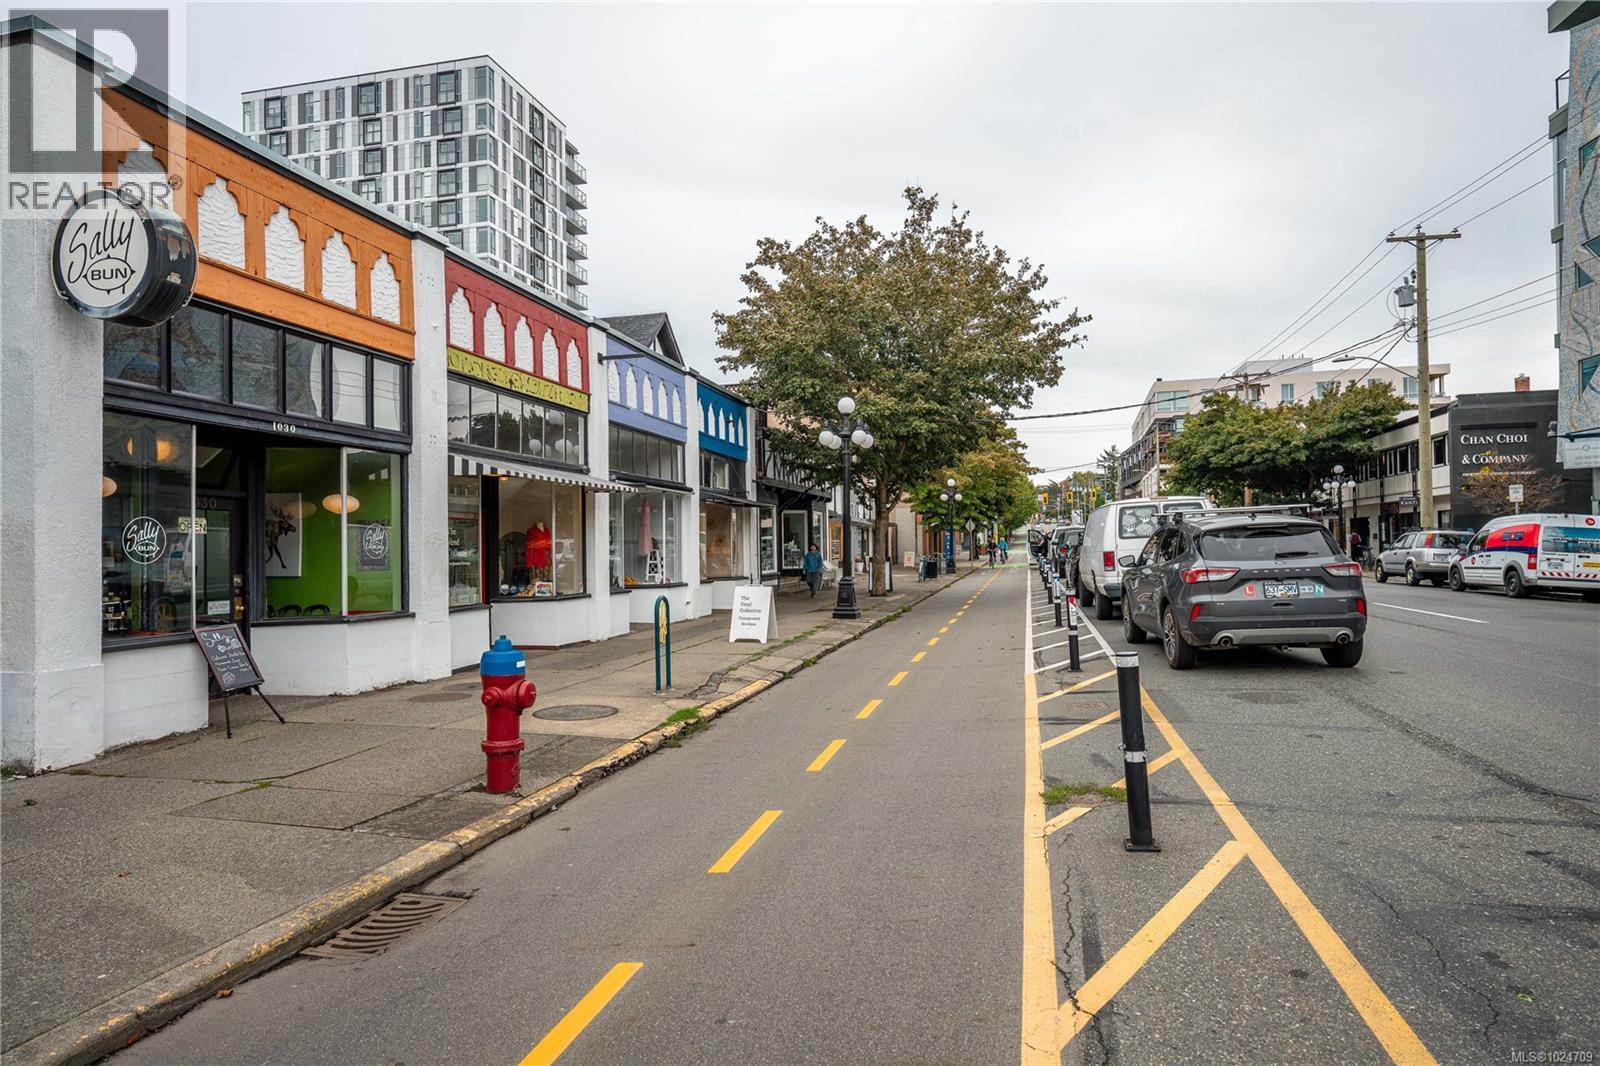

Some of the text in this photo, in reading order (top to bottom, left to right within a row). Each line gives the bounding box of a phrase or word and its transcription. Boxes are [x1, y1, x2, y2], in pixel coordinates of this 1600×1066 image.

[68, 209, 134, 294] Sally
[91, 267, 127, 281] BUN
[273, 421, 296, 433] 1030
[1461, 454, 1470, 464] &
[126, 521, 160, 558] Sally
[1315, 584, 1324, 593] N
